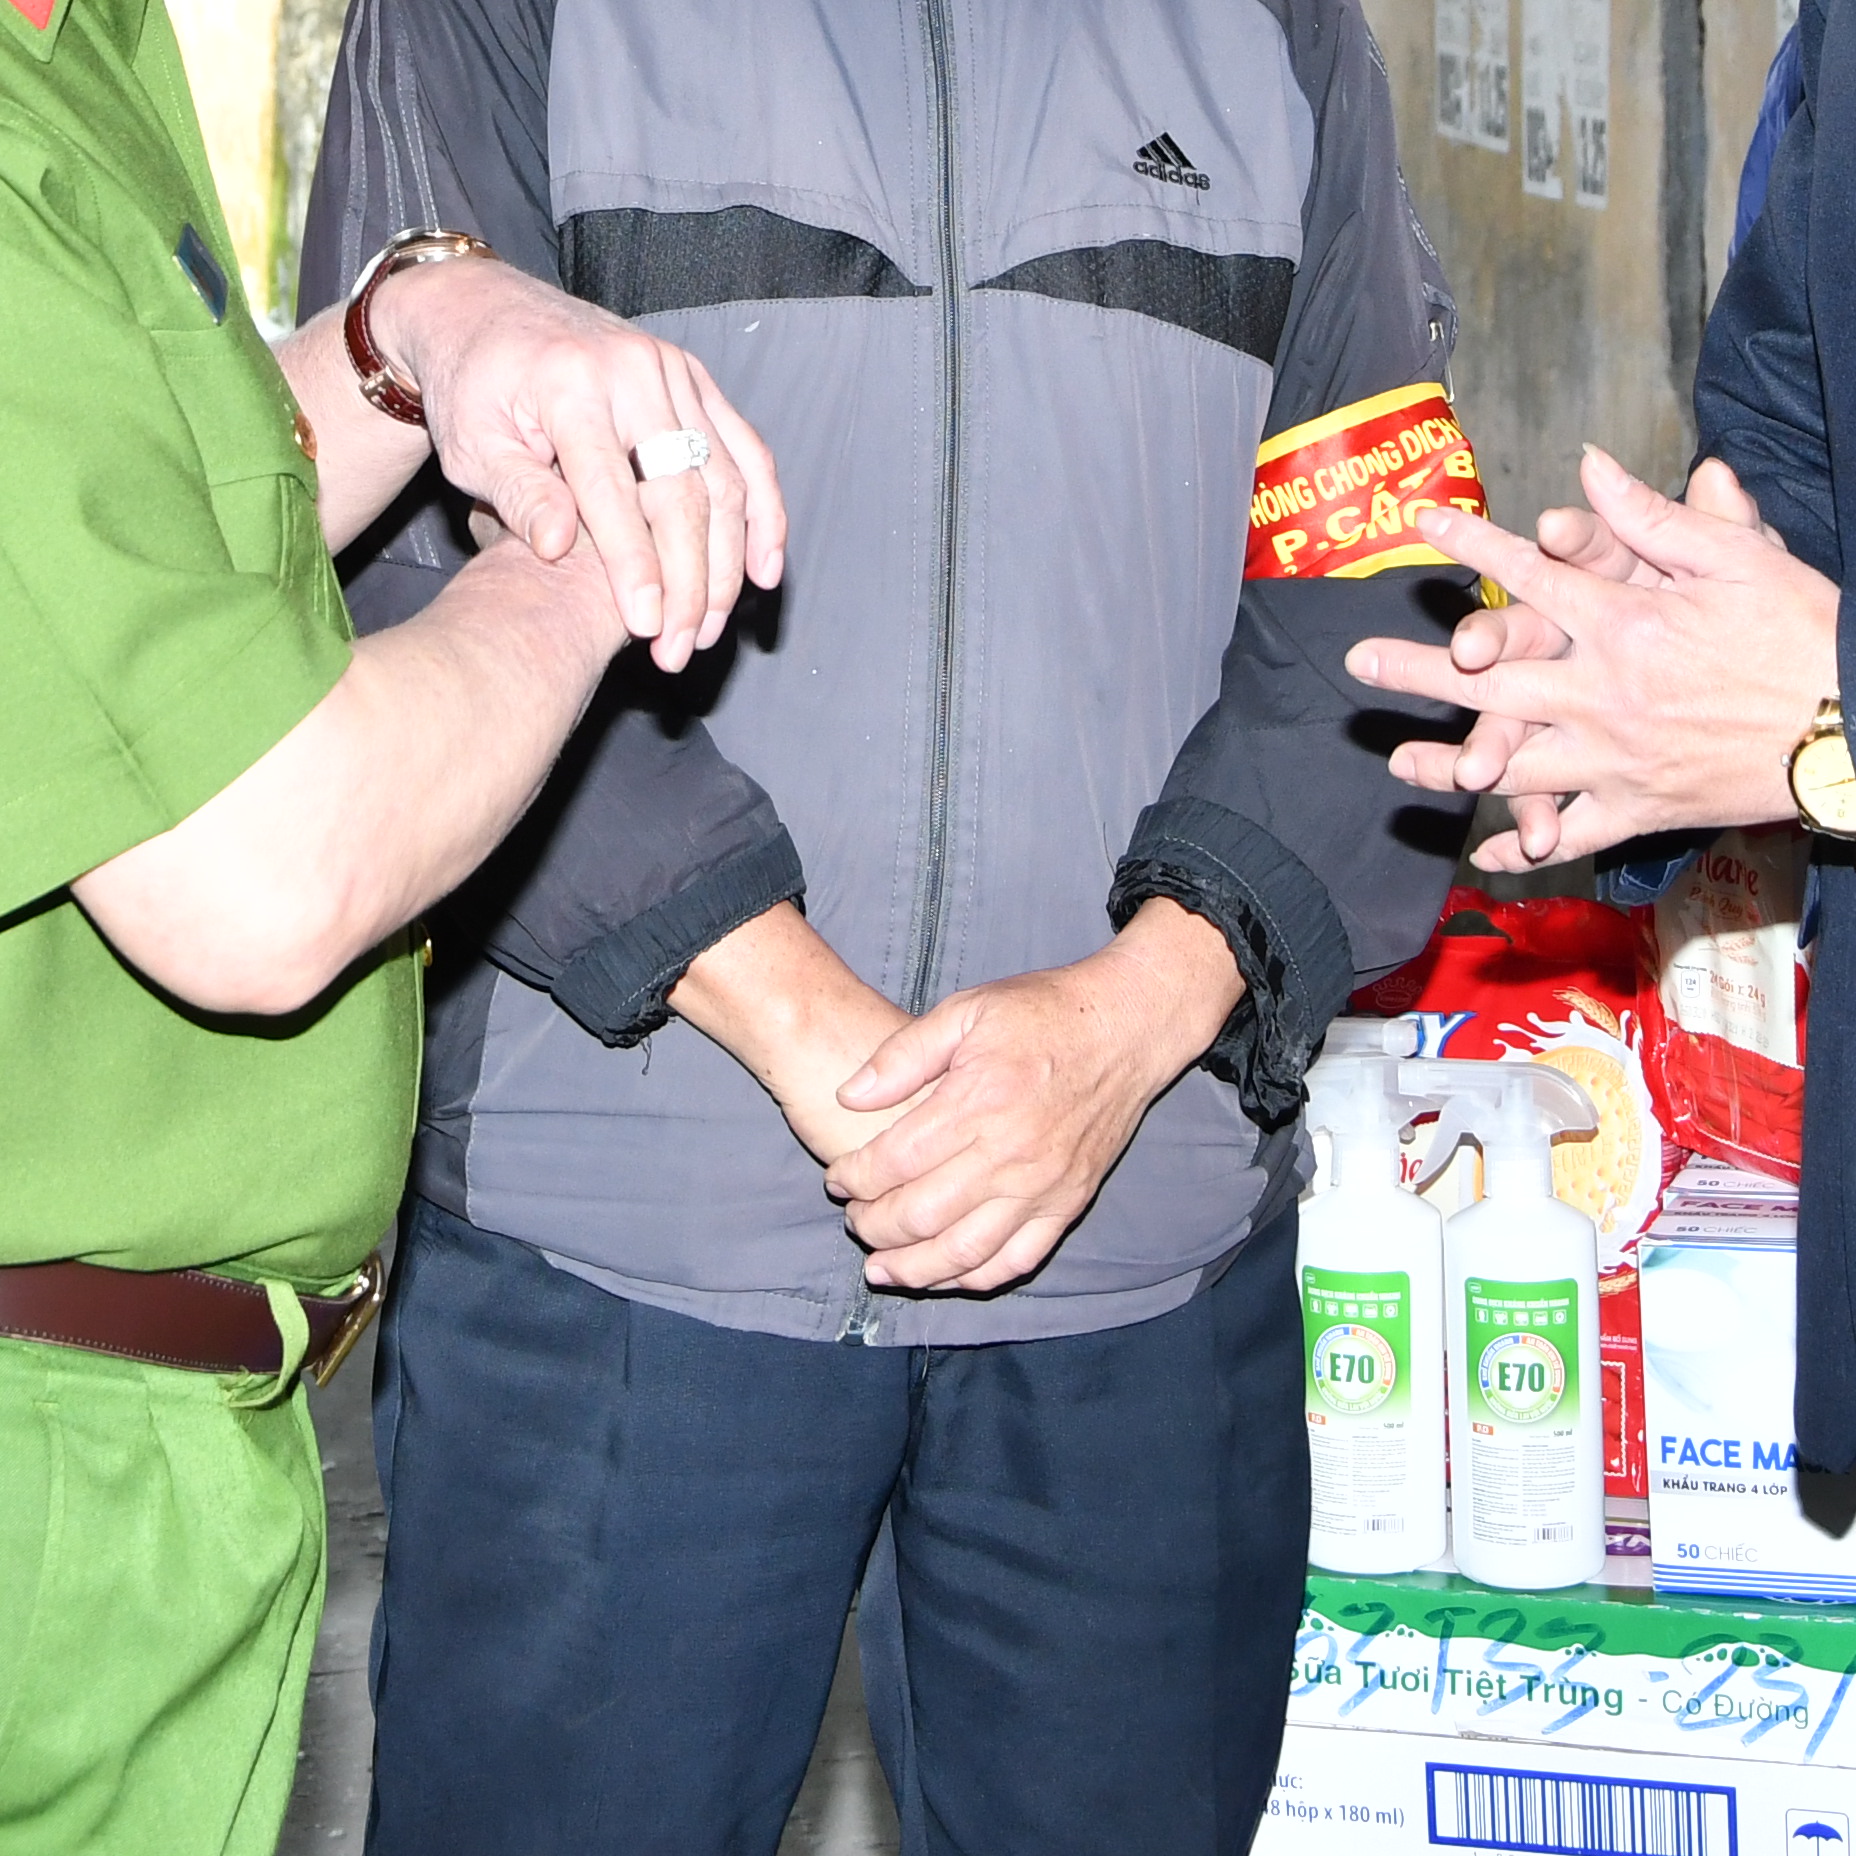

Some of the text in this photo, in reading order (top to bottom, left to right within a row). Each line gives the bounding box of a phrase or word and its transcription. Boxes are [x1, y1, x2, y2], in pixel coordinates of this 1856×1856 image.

[1132, 159, 1212, 191] adidas
[1679, 1199, 1764, 1212] FACE
[1329, 1351, 1375, 1384] E70
[1498, 1361, 1545, 1393] E70
[1660, 1435, 1742, 1469] FACE
[1662, 1474, 1788, 1496] KHẨU TRANG 4 LỚP
[1676, 1542, 1759, 1563] 50 CHIẾC
[1354, 1660, 1430, 1693] Tươi
[1444, 1668, 1507, 1705] Tiệt
[1520, 1674, 1623, 1716] Trùng
[1662, 1689, 1702, 1716] Có
[1714, 1692, 1809, 1730] Đường
[1285, 1799, 1406, 1828] hộp x 180 ml)
